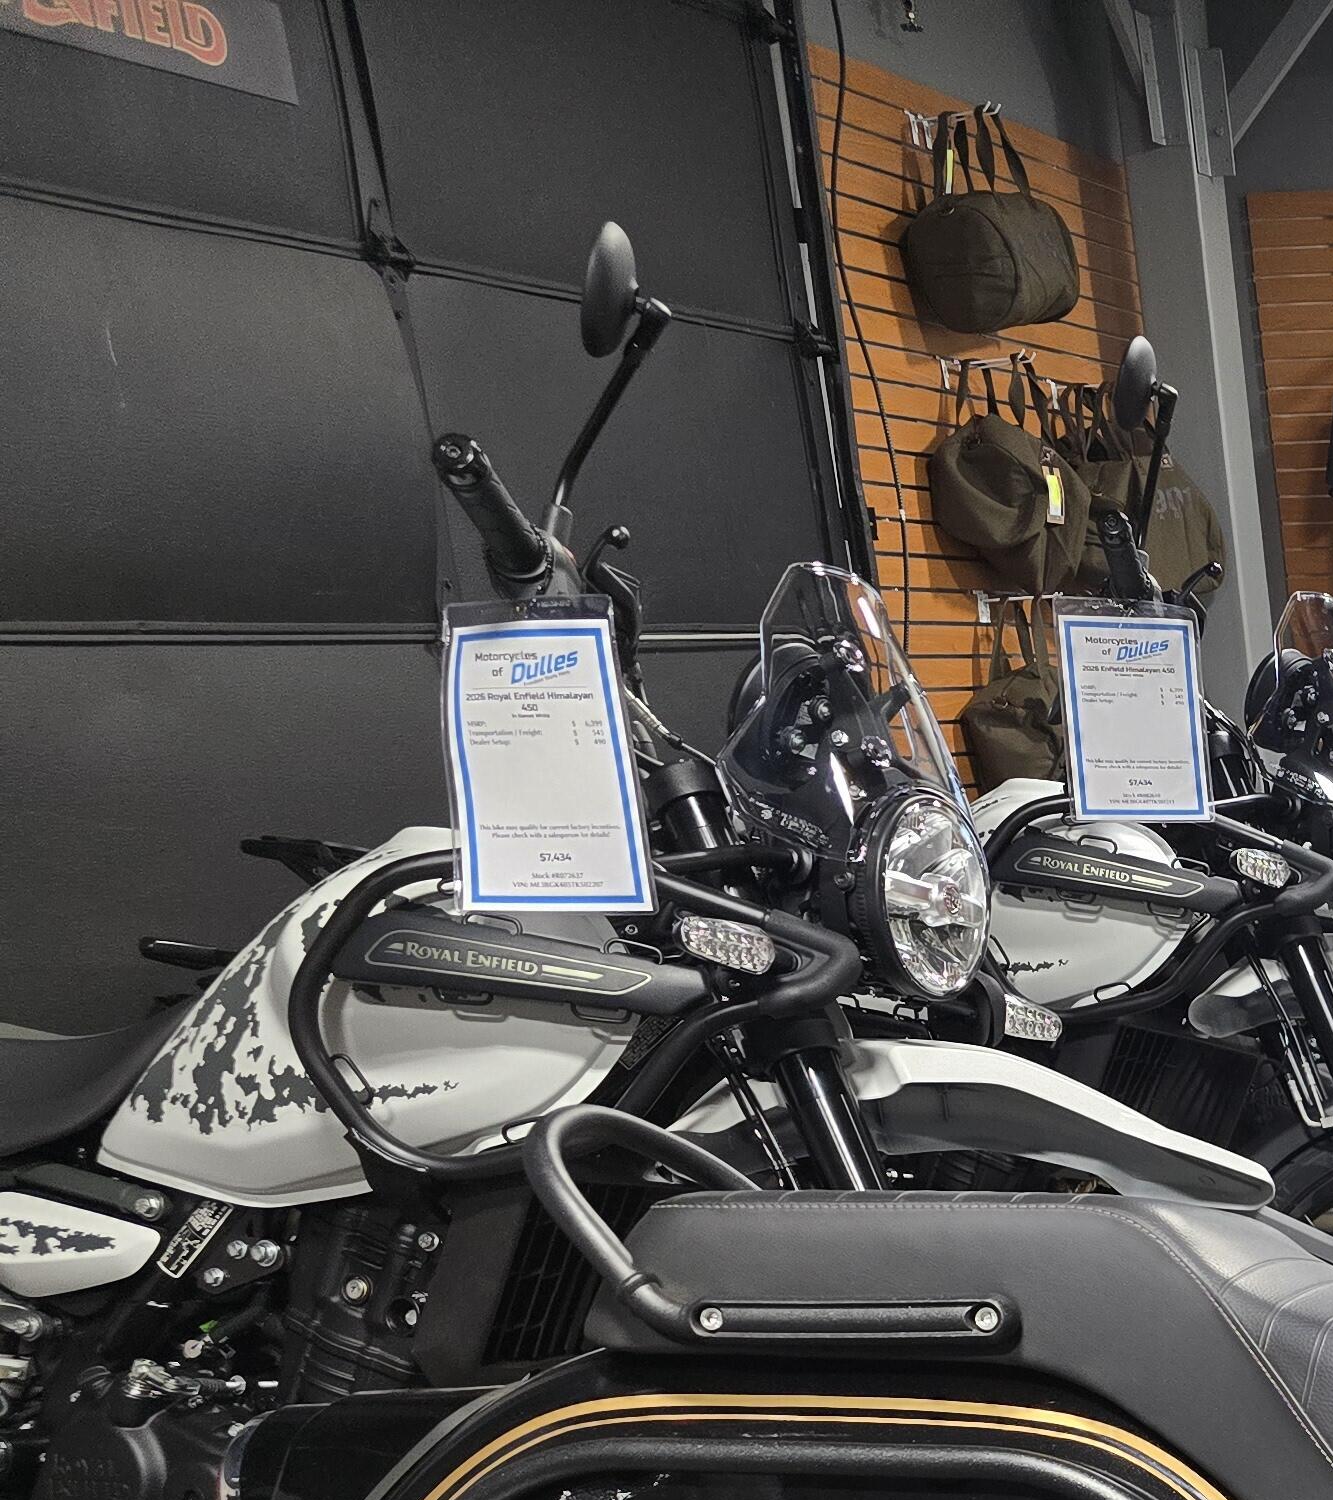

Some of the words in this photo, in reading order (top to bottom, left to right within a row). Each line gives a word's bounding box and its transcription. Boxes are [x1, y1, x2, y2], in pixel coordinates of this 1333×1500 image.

[1085, 636, 1138, 646] Motorcycles
[1101, 647, 1112, 655] of
[1116, 640, 1170, 661] Dulles
[475, 651, 537, 662] Motorcycles
[492, 666, 503, 677] of
[511, 651, 578, 684] Dulles
[1126, 666, 1160, 674] Himalayan
[487, 692, 512, 702] Royal
[514, 692, 545, 700] Enfield
[547, 691, 593, 701] Himalayan
[521, 704, 539, 712] 450
[1042, 856, 1080, 873] ROYAL
[1082, 863, 1130, 882] ENFIELD
[406, 941, 463, 964] ROYAL
[466, 950, 539, 976] ENFIELD
